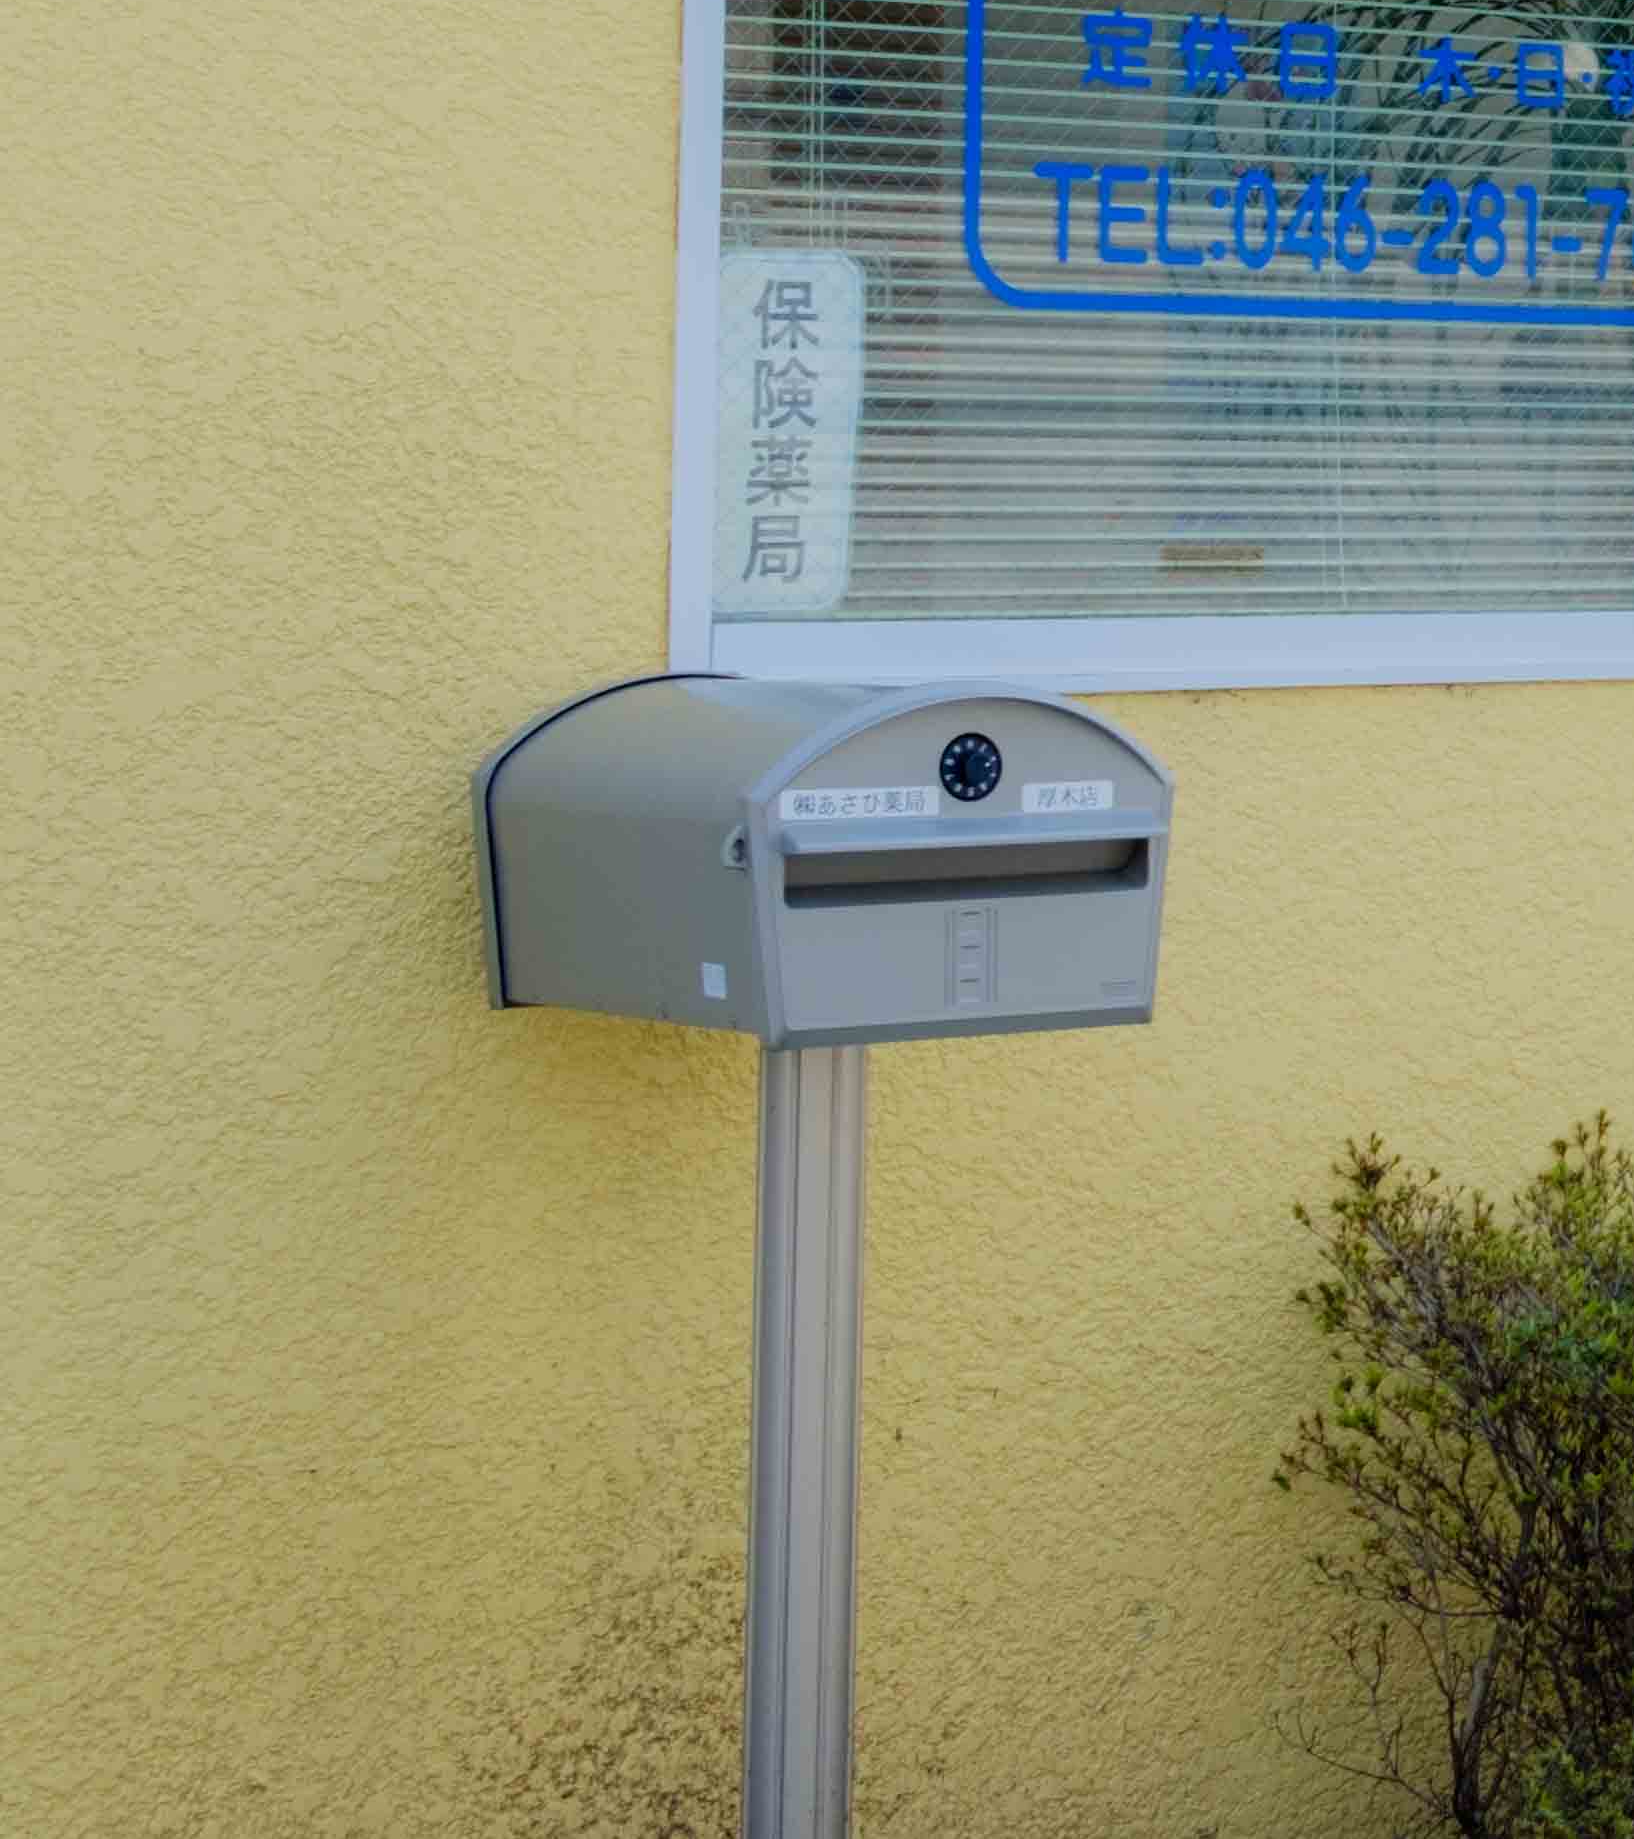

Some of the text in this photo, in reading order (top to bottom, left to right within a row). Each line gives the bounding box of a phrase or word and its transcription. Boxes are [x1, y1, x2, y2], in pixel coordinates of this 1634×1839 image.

[1081, 7, 1338, 100] 定休日
[742, 279, 820, 583] 保険薬局
